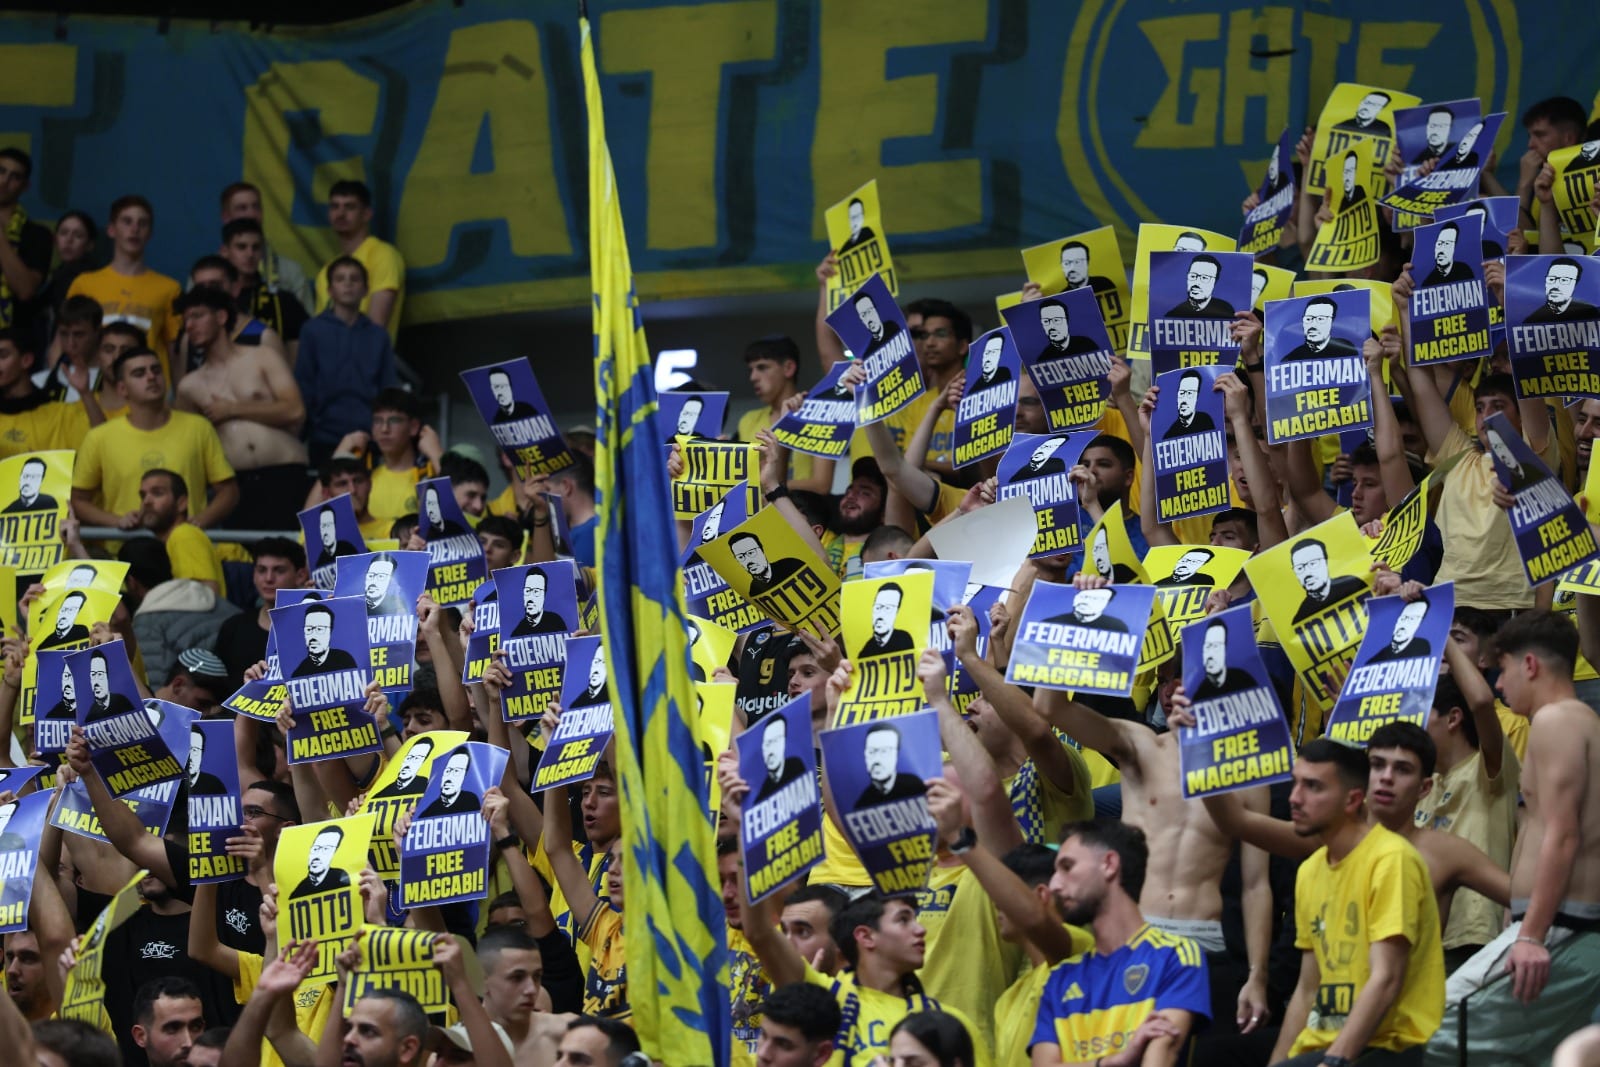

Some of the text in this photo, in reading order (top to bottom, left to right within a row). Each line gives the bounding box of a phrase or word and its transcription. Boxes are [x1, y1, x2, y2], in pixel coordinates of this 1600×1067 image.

[1413, 279, 1484, 317] FEDERMAN
[1433, 313, 1468, 337] FREE
[1512, 321, 1600, 355] FEDERMA
[1414, 329, 1489, 362] MACCABI!
[1543, 352, 1590, 373] FREE
[876, 365, 904, 399] FREE
[1030, 349, 1113, 387] FEDERMAN
[1271, 357, 1367, 393] FEDERMAN
[1520, 374, 1600, 396] MACCAB
[858, 371, 923, 424] MACCABI!
[958, 380, 1017, 423] FEDERMAN
[1063, 381, 1100, 404] FREE
[1295, 387, 1340, 412] FREE
[799, 424, 836, 440] FREE
[971, 413, 998, 439] FREE
[1273, 401, 1369, 440] MACCABI!
[773, 428, 847, 455] MACCABI!
[955, 424, 1013, 466] MACCABI!
[1156, 431, 1224, 470] FEDERMAN
[686, 446, 748, 482] פדרמן
[1175, 466, 1207, 493] FREE
[1160, 483, 1228, 519] MACCABI!
[1538, 513, 1571, 548] FREE
[1526, 527, 1597, 582] MACCABI!
[434, 562, 467, 586] FREE
[502, 633, 572, 667] FEDERMA
[1024, 622, 1138, 656] FEDERMAN
[760, 658, 776, 686] 9
[1047, 648, 1102, 669] FREE
[286, 669, 368, 709] FEDERMAN
[525, 668, 562, 691] FREE
[856, 653, 916, 705] פדרמן
[1013, 663, 1128, 690] MACCABI!
[1346, 657, 1437, 697] FEDERMAN
[310, 707, 349, 731] FREE
[1358, 692, 1403, 719] FREE
[118, 745, 152, 767] FREE
[292, 723, 378, 760] MACCABI!
[558, 737, 594, 761] FREE
[1213, 729, 1261, 763] FREE
[107, 755, 184, 796] MACCABI!
[536, 751, 600, 788] MACCABI!
[1187, 747, 1290, 795] MACCABI!
[746, 770, 817, 843] FEDERMAN
[846, 800, 938, 844] FEDERMA
[406, 812, 488, 852] FEDERMAN
[765, 819, 800, 858] FREE
[426, 850, 464, 876] FREE
[749, 829, 823, 900] MACCABI!
[889, 834, 932, 865] FREE
[405, 868, 484, 905] MACCABI!
[288, 890, 353, 940] פדרמן
